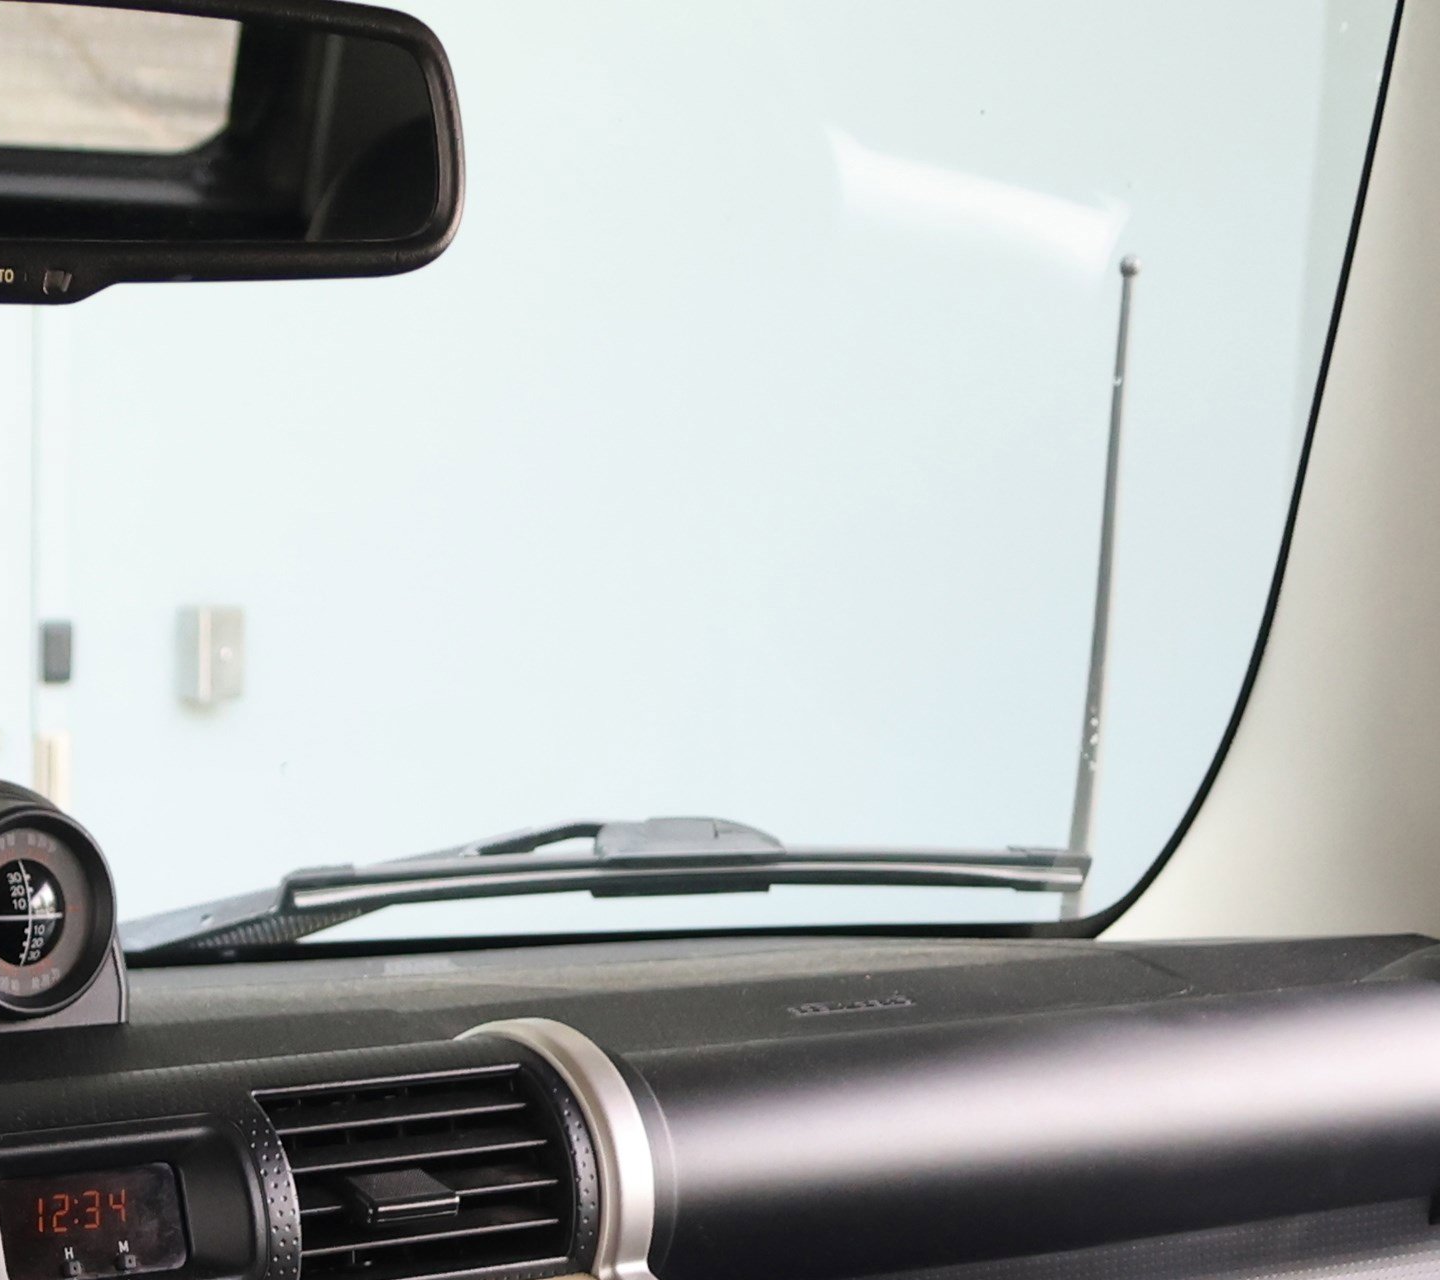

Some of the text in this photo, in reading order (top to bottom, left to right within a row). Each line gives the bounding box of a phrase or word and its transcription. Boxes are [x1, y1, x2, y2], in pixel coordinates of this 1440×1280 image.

[7, 872, 22, 884] 30
[10, 885, 26, 897] 20
[12, 899, 27, 910] 10
[33, 924, 46, 935] 10
[31, 937, 45, 948] 20
[37, 1189, 126, 1233] 12:34
[119, 1240, 129, 1253] M
[64, 1246, 74, 1260] H
